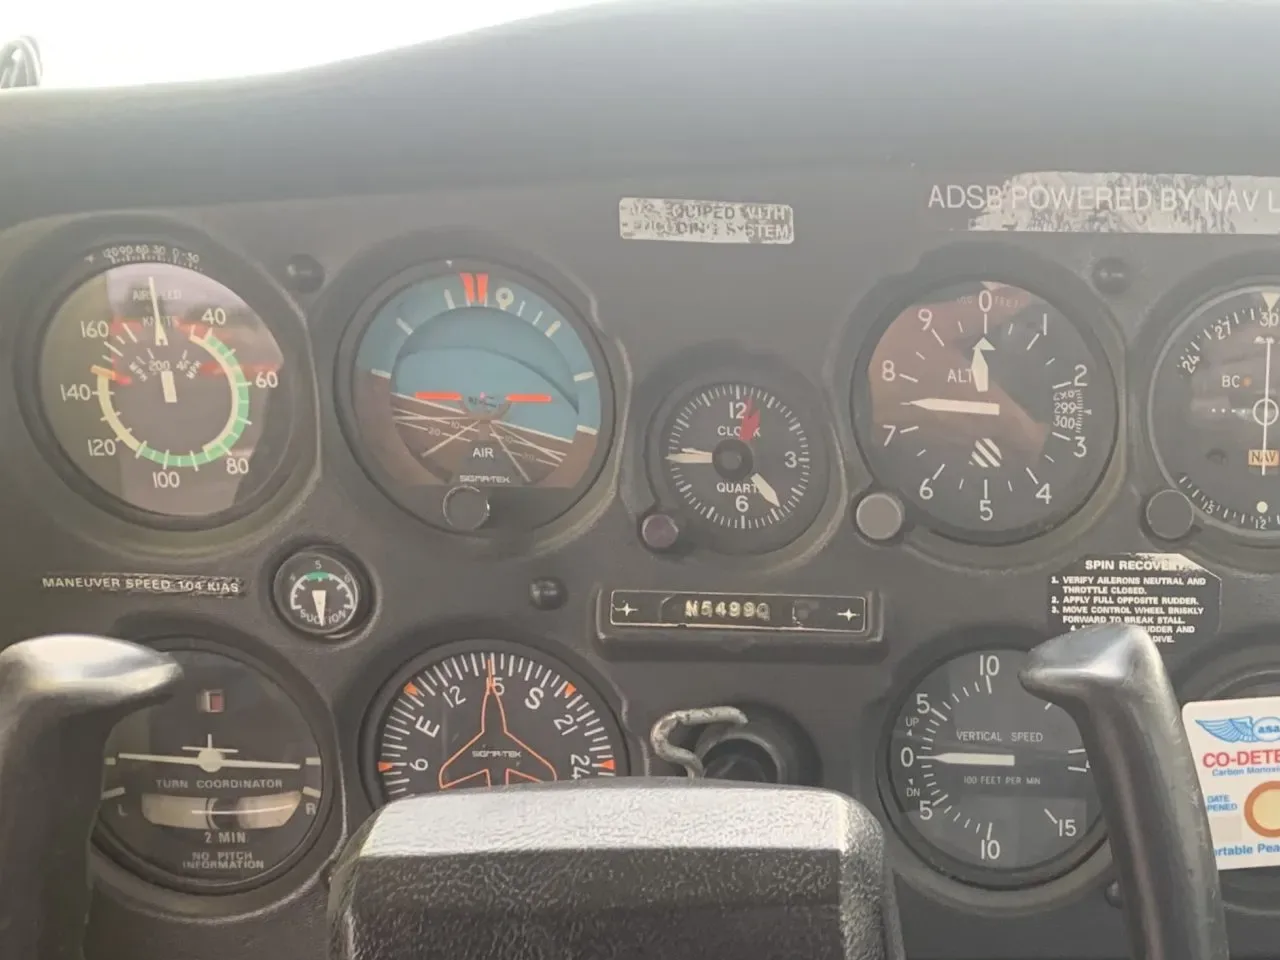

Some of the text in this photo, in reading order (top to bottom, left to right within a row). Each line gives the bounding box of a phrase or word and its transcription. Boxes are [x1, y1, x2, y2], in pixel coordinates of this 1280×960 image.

[1011, 186, 1151, 213] POWERED
[1161, 187, 1200, 213] BY
[1204, 189, 1260, 213] NAV
[978, 290, 993, 312] 0
[201, 308, 226, 326] 40
[917, 308, 932, 330] 9
[80, 320, 109, 338] 160
[881, 359, 896, 381] 8
[1074, 364, 1088, 387] 2
[255, 371, 278, 388] 60
[1221, 375, 1241, 388] BC
[60, 383, 91, 401] 140
[728, 402, 747, 419] 12
[883, 424, 896, 447] 7
[87, 438, 116, 456] 120
[472, 447, 494, 459] AIR
[1073, 436, 1087, 457] 3
[784, 452, 798, 469] 3
[1251, 451, 1277, 463] NAV
[226, 458, 249, 475] 80
[152, 471, 180, 489] 100
[919, 478, 934, 500] 6
[1035, 483, 1052, 504] 4
[735, 495, 749, 513] 6
[979, 500, 993, 521] 5
[1084, 559, 1115, 570] SPIN
[42, 576, 239, 593] MANEUVER SPEED 104 KIAS
[1062, 576, 1206, 586] VERIFY AILERONS NEUTRAL AND
[1062, 586, 1108, 595] THROTTLE
[1062, 596, 1090, 604] APPLY
[1093, 596, 1114, 605] FULL
[1117, 596, 1159, 605] OPPOSITE
[1062, 606, 1205, 616] MOVE CONTROL WHEEL BRISKLY
[1062, 615, 1107, 624] FORWARD
[1109, 616, 1122, 624] TO
[1124, 616, 1154, 625] BREAK
[1176, 625, 1196, 634] AND
[979, 654, 1000, 676] 10
[441, 685, 467, 709] 12
[523, 687, 545, 710] S
[916, 693, 930, 714] 5
[414, 715, 441, 739] E
[553, 714, 579, 736] 21
[905, 717, 920, 727] UP
[1257, 725, 1280, 735] asa
[956, 731, 1044, 743] VERTICAL SPEED
[900, 746, 914, 768] 0
[1026, 776, 1041, 785] MIN
[1211, 767, 1245, 777] Carbon
[156, 779, 283, 790] TURN COORDINATOR
[906, 787, 921, 797] DN
[1207, 794, 1230, 803] DATE
[919, 800, 933, 821] 5
[1058, 819, 1077, 837] 15
[218, 831, 247, 844] MIN
[980, 839, 1001, 860] 10
[181, 860, 265, 871] INFORMATION
